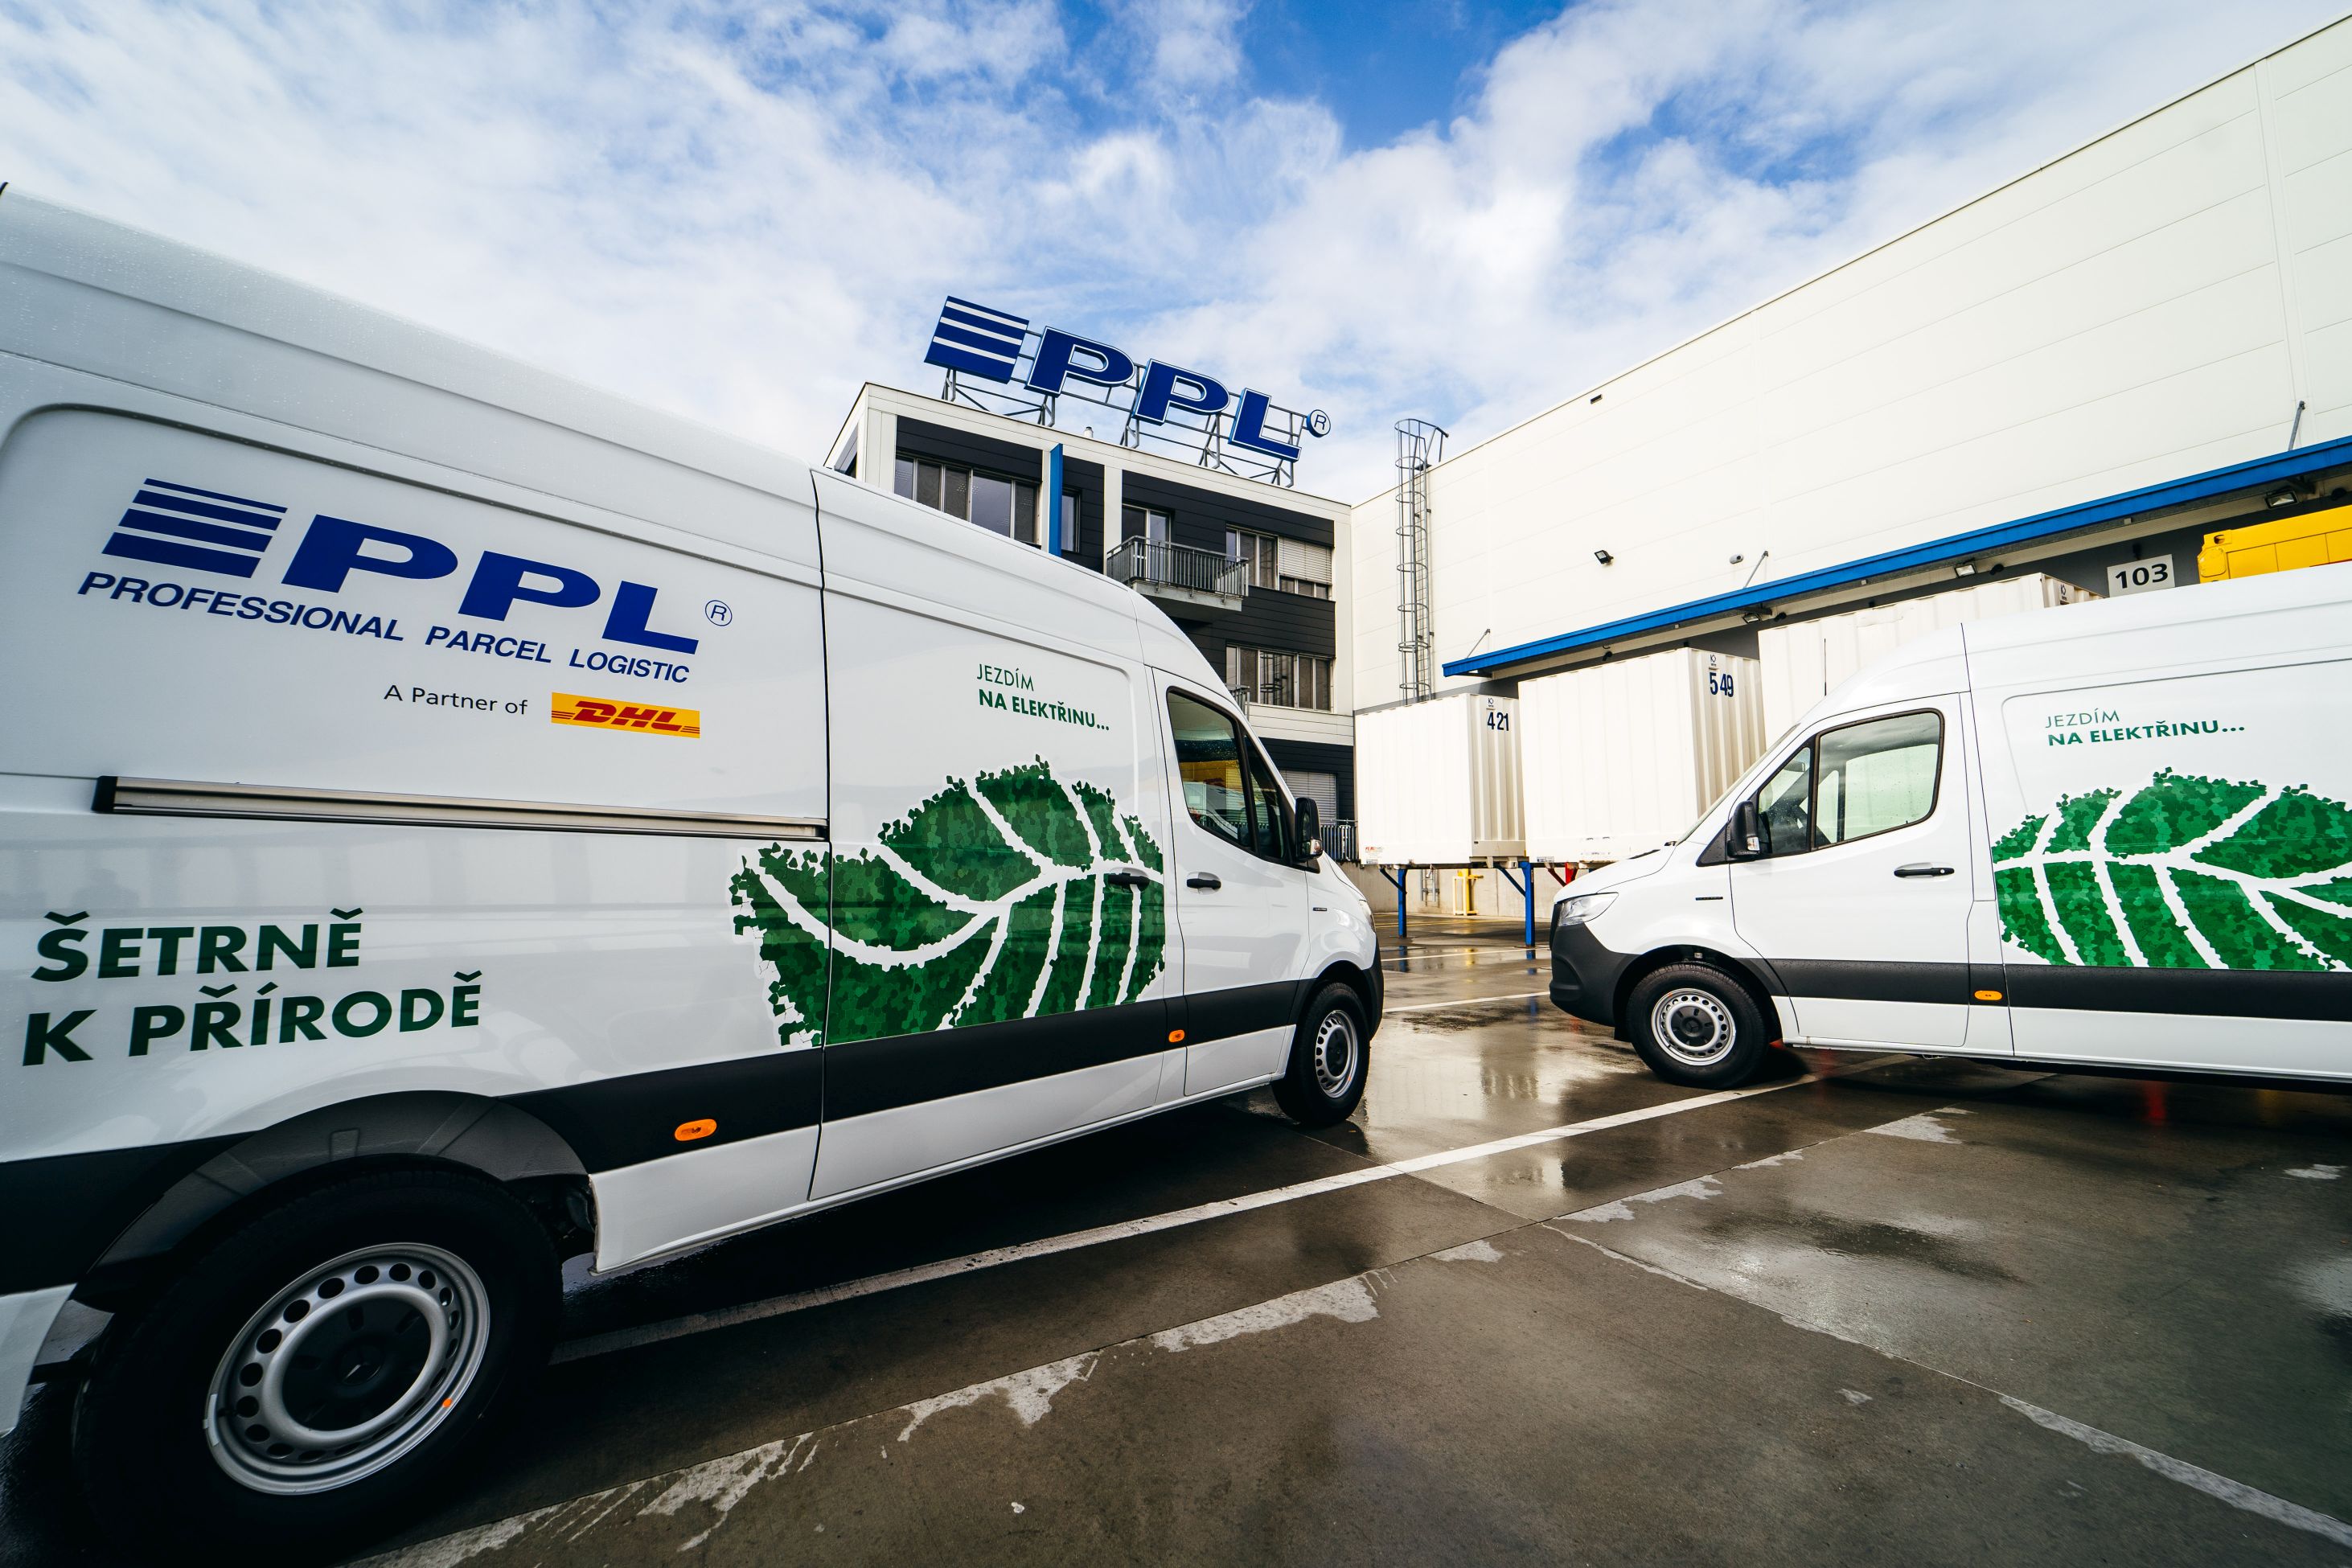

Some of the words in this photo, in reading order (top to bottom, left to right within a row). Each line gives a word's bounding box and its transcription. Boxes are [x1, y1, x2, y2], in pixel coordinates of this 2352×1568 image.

[1024, 326, 1302, 462] PPL
[281, 514, 699, 655] PPL
[2115, 563, 2169, 589] 103
[77, 571, 404, 642] PROFESSIONAL
[425, 626, 552, 664] PARCEL
[569, 649, 691, 684] LOGISTIC
[976, 663, 1034, 691] JEZDÍM
[1710, 671, 1734, 698] 549
[384, 684, 403, 701] A
[412, 687, 499, 712] Partner
[504, 699, 528, 716] of
[573, 700, 683, 732] DHL
[979, 689, 1008, 711] NA
[1012, 696, 1110, 731] ELEKTŘINU...
[1487, 712, 1509, 732] 421
[2045, 708, 2120, 729] JEZDÍM
[2048, 732, 2084, 746] NA
[2090, 718, 2245, 743] ELEKTŘINU...
[31, 907, 363, 983] ŠETRNĚ
[23, 1009, 97, 1066] K
[129, 970, 482, 1057] PŘÍRODĚ
